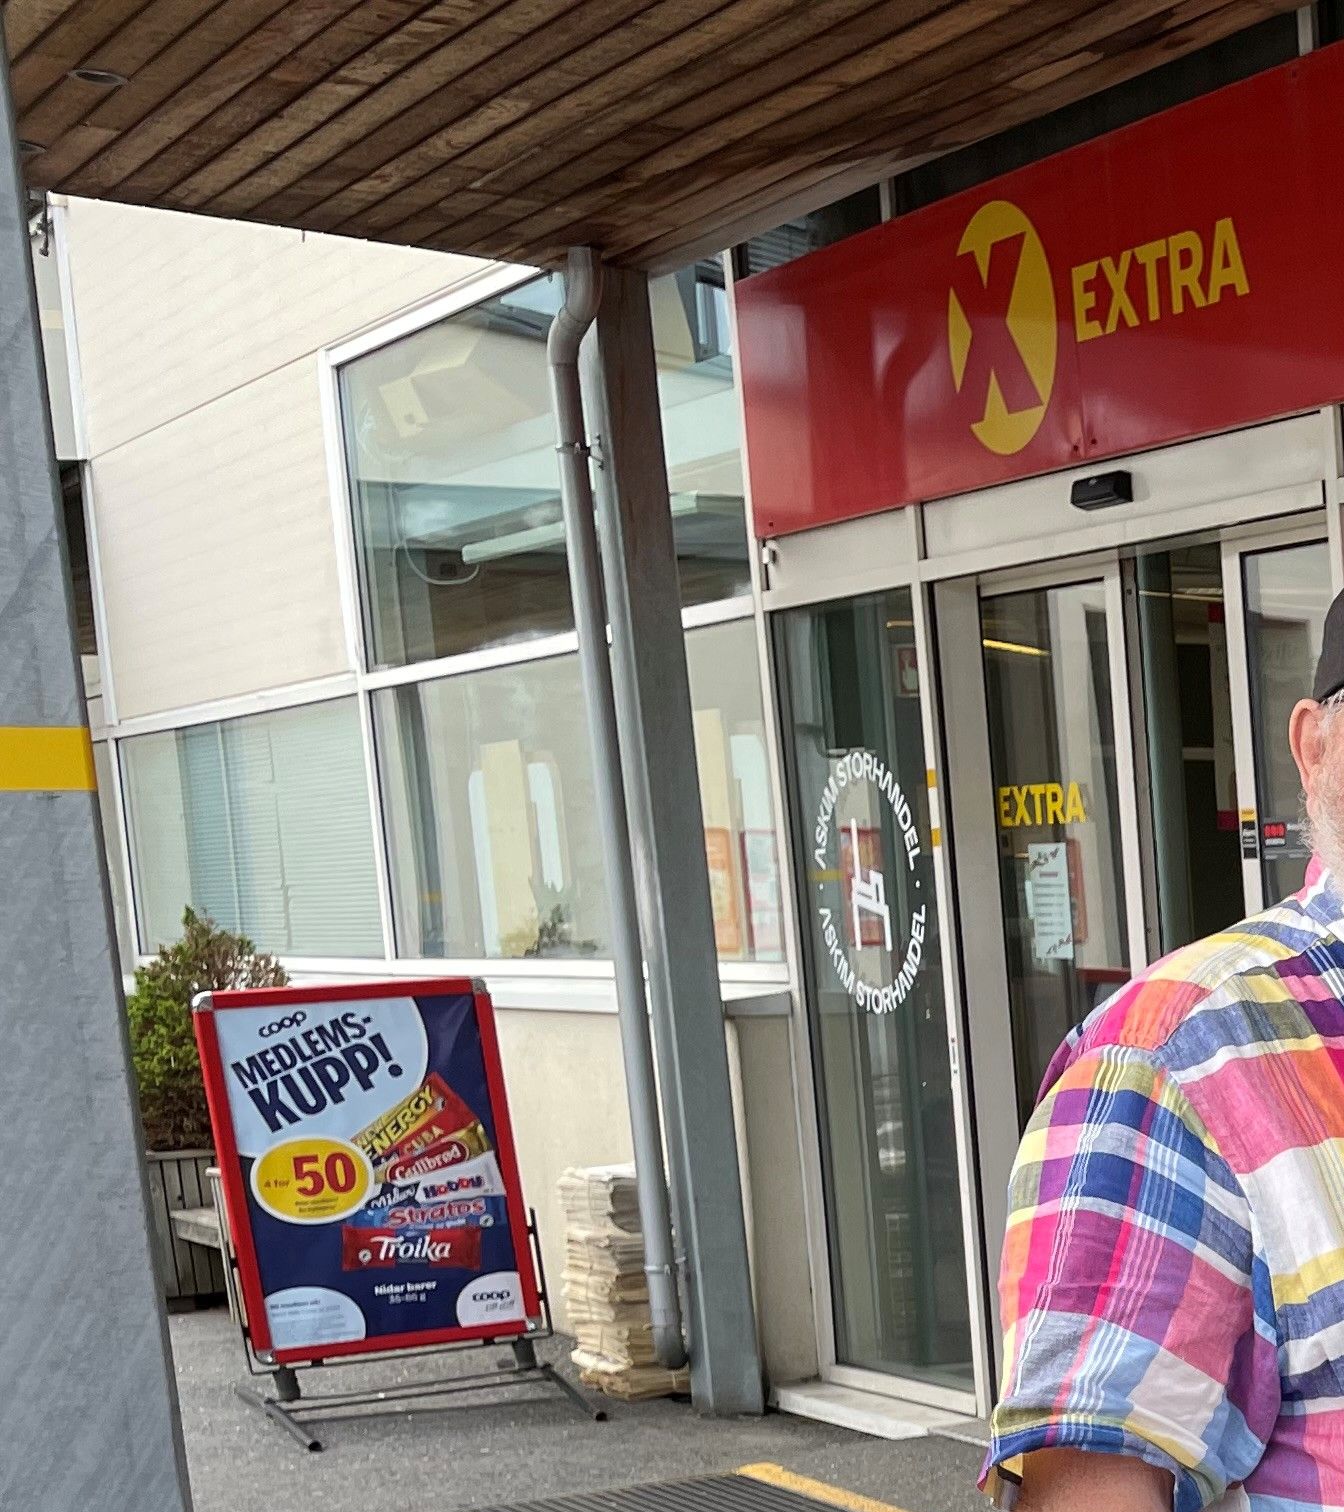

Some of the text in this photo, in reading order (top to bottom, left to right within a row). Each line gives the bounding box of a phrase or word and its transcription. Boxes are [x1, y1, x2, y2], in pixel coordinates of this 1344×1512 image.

[1071, 217, 1250, 343] EXTRA
[836, 751, 920, 871] STORHANDEL
[999, 780, 1088, 827] EXTRA
[855, 904, 926, 1014] STORHANDEL
[231, 1012, 372, 1089] MEDLEMS-
[247, 1032, 403, 1133] KUPP!
[293, 1152, 356, 1197] 50
[370, 1234, 451, 1262] Troika
[387, 1199, 486, 1228] Stratos
